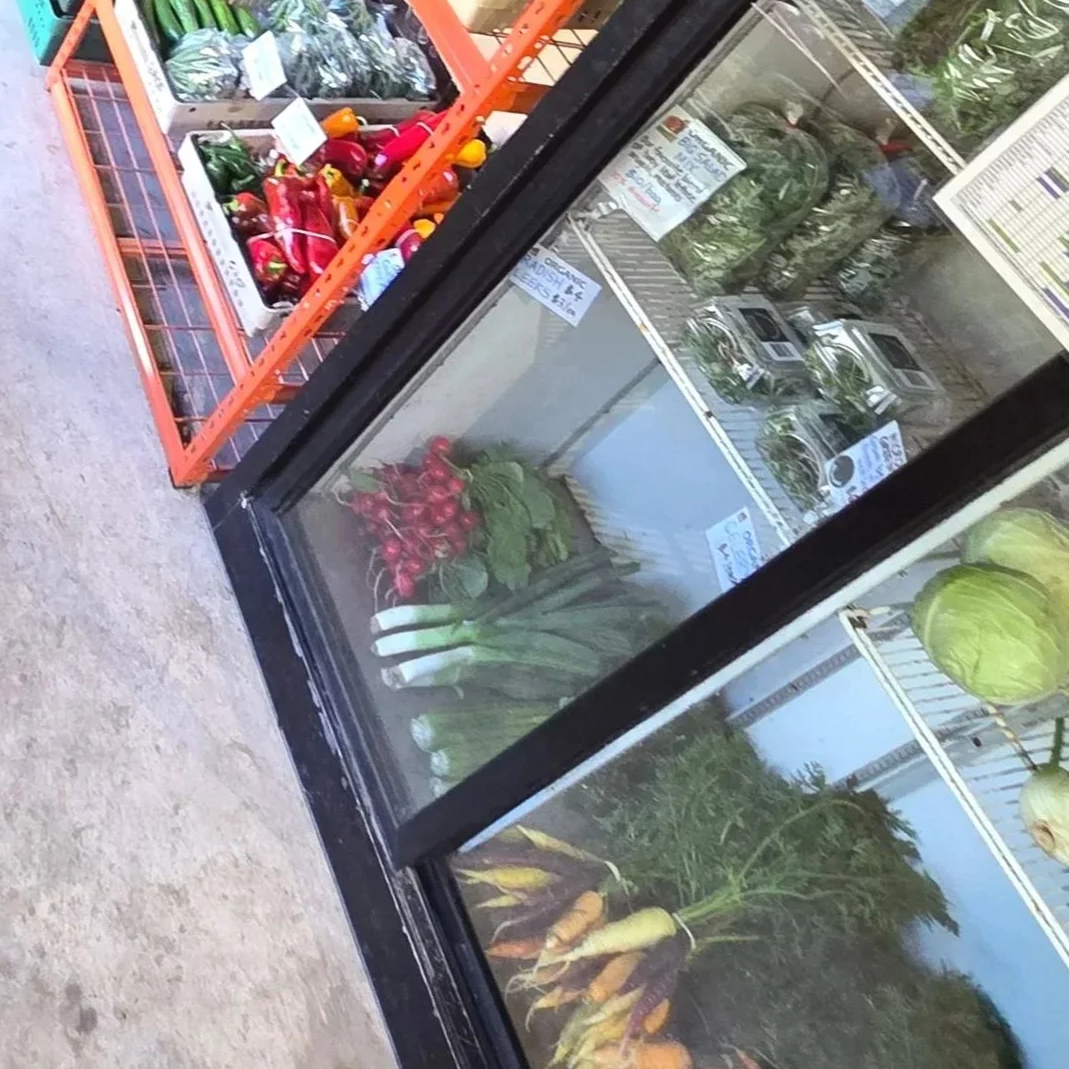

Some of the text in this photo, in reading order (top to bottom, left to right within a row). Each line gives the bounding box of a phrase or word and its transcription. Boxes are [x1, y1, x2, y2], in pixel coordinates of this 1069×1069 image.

[512, 268, 552, 298] LEEKS
[520, 255, 565, 288] RADISH
[542, 257, 587, 288] ORGANIC
